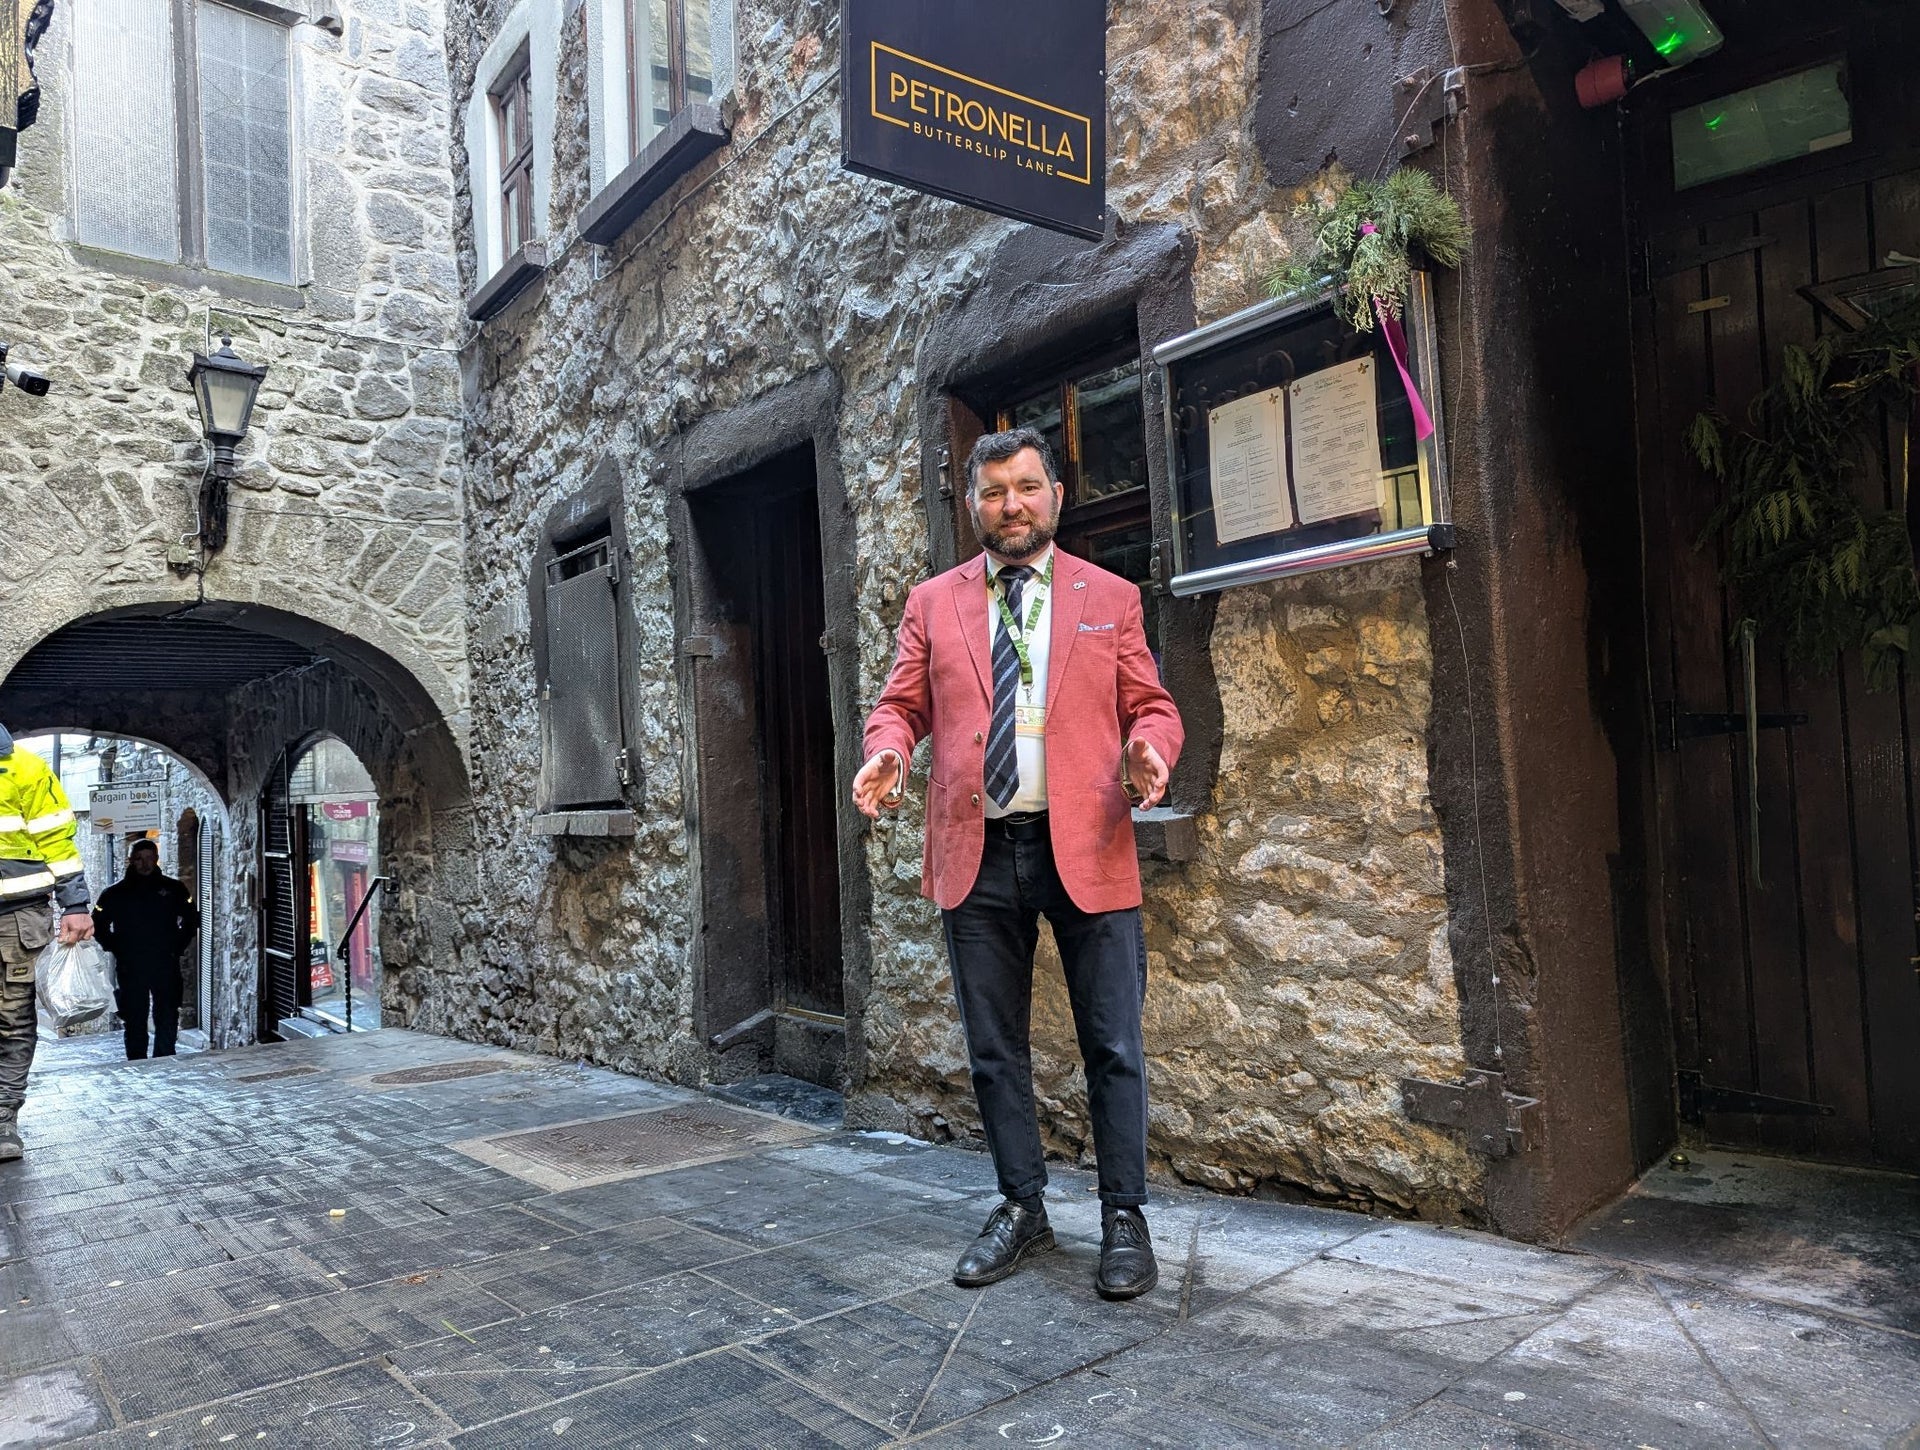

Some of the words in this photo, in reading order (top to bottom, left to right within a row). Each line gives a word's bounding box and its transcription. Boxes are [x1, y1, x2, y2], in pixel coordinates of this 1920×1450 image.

[890, 72, 1075, 162] PETRONELLA
[913, 121, 1007, 160] BUTTERSLIP
[1016, 154, 1054, 176] LANE
[91, 791, 127, 804] bargain
[130, 790, 157, 800] books
